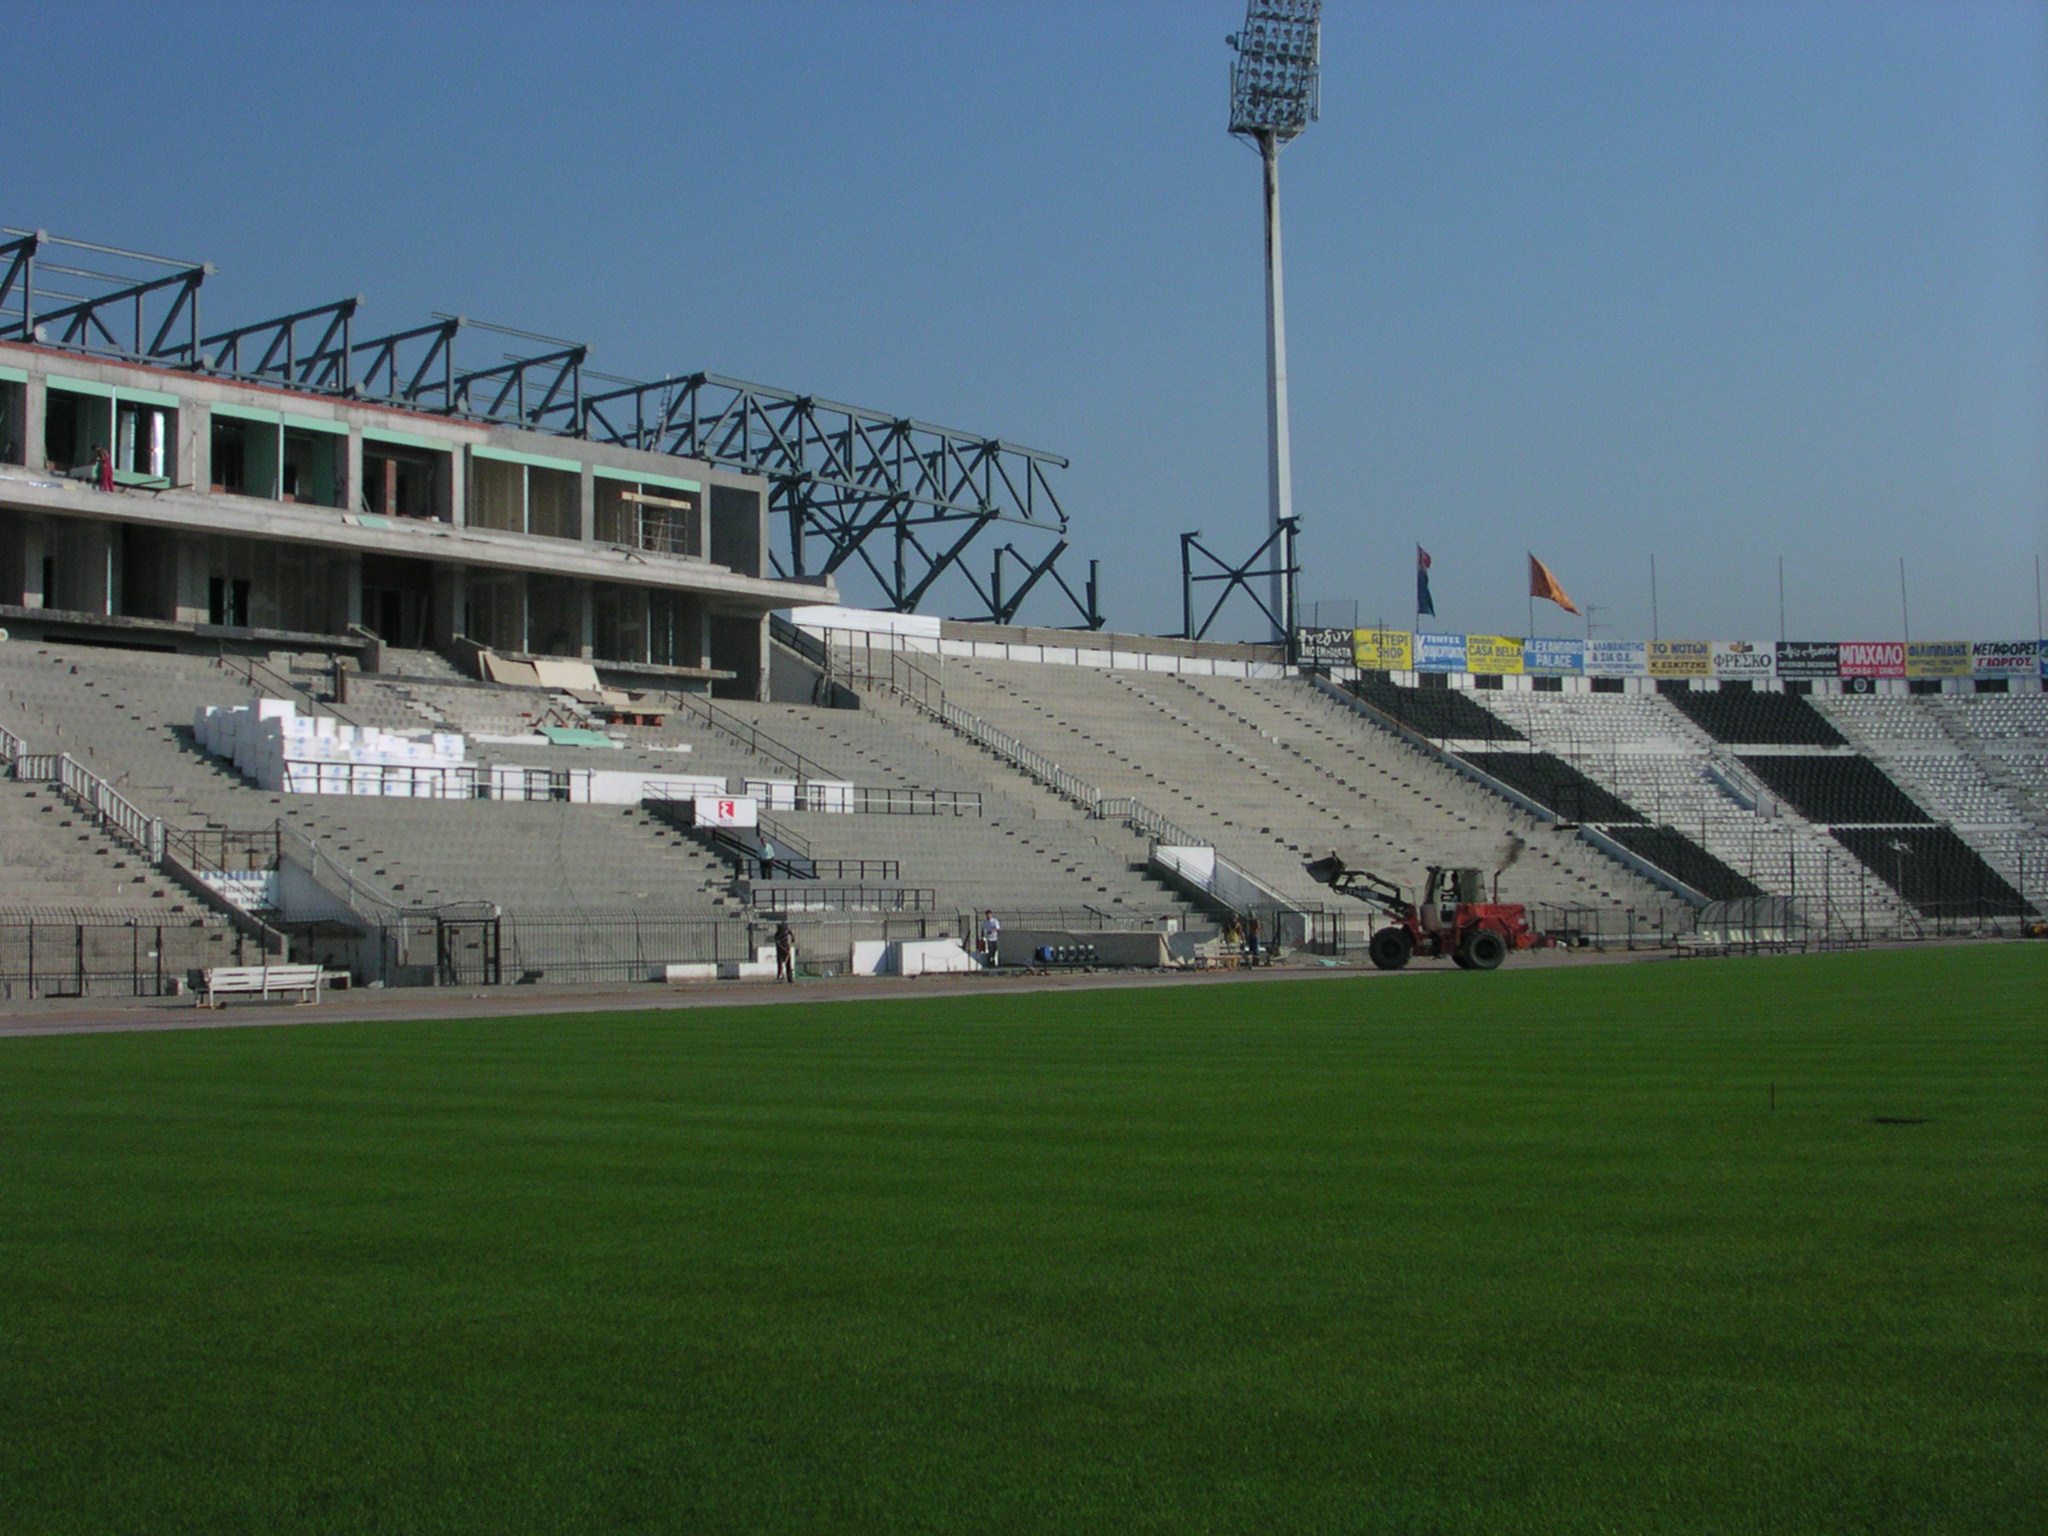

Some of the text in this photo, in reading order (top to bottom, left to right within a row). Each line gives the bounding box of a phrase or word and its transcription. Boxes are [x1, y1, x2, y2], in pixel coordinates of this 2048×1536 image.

[1376, 647, 1404, 659] SHOP
[1468, 645, 1523, 657] CASA BELLA
[1524, 641, 1582, 654] ALEXANDROS
[1972, 642, 2038, 656] ΜΕΤΑΦΟΡΕΣ
[1536, 654, 1572, 668] PALACE
[1713, 654, 1772, 668] ΦΡΕΣΚΟ
[1840, 645, 1903, 665] ΜΠΑΧΑΛΟ
[1977, 657, 2032, 667] ΓΙΩΡΓΟΣ
